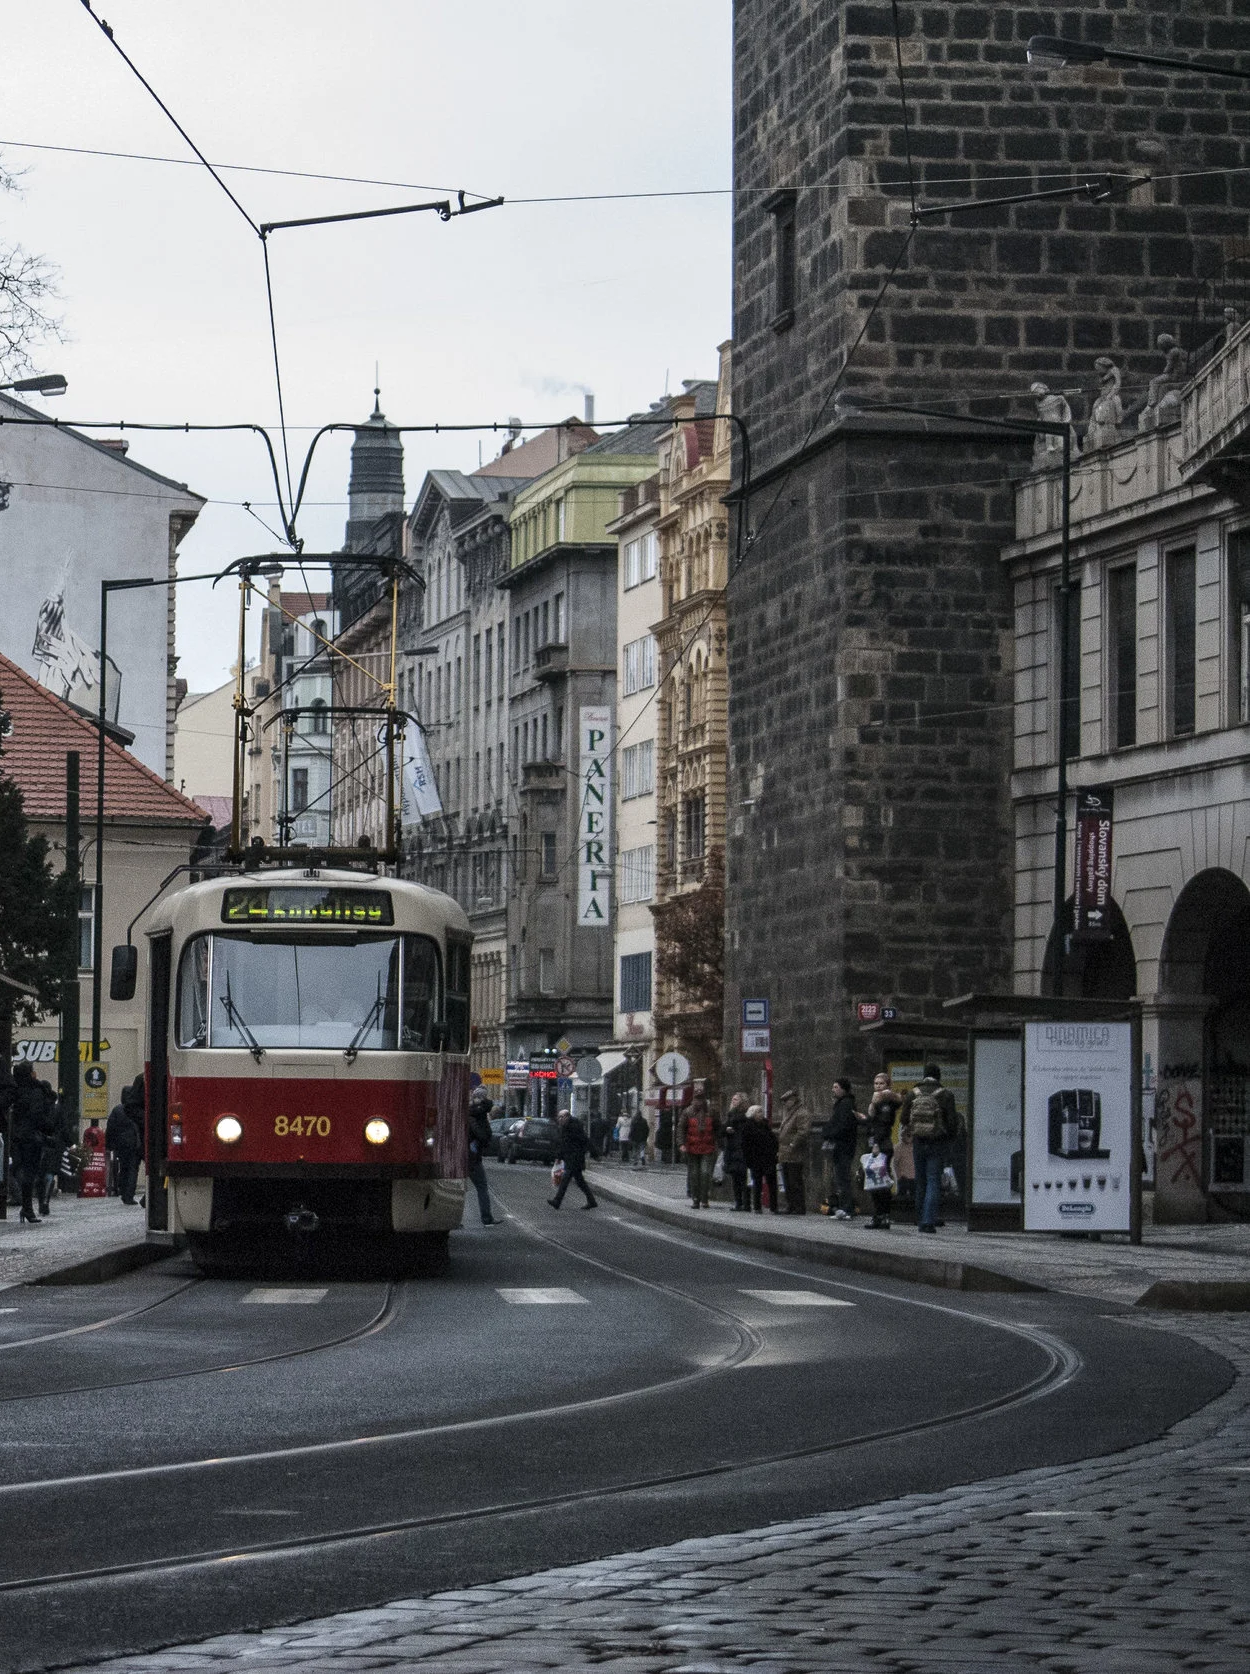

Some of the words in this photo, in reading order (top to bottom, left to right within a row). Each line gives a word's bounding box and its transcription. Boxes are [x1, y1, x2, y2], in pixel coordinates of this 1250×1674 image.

[584, 729, 606, 919] PANERIA
[1095, 820, 1110, 878] Slovanský
[229, 892, 269, 919] 24
[884, 1010, 893, 1018] 33
[274, 1115, 331, 1136] 8470
